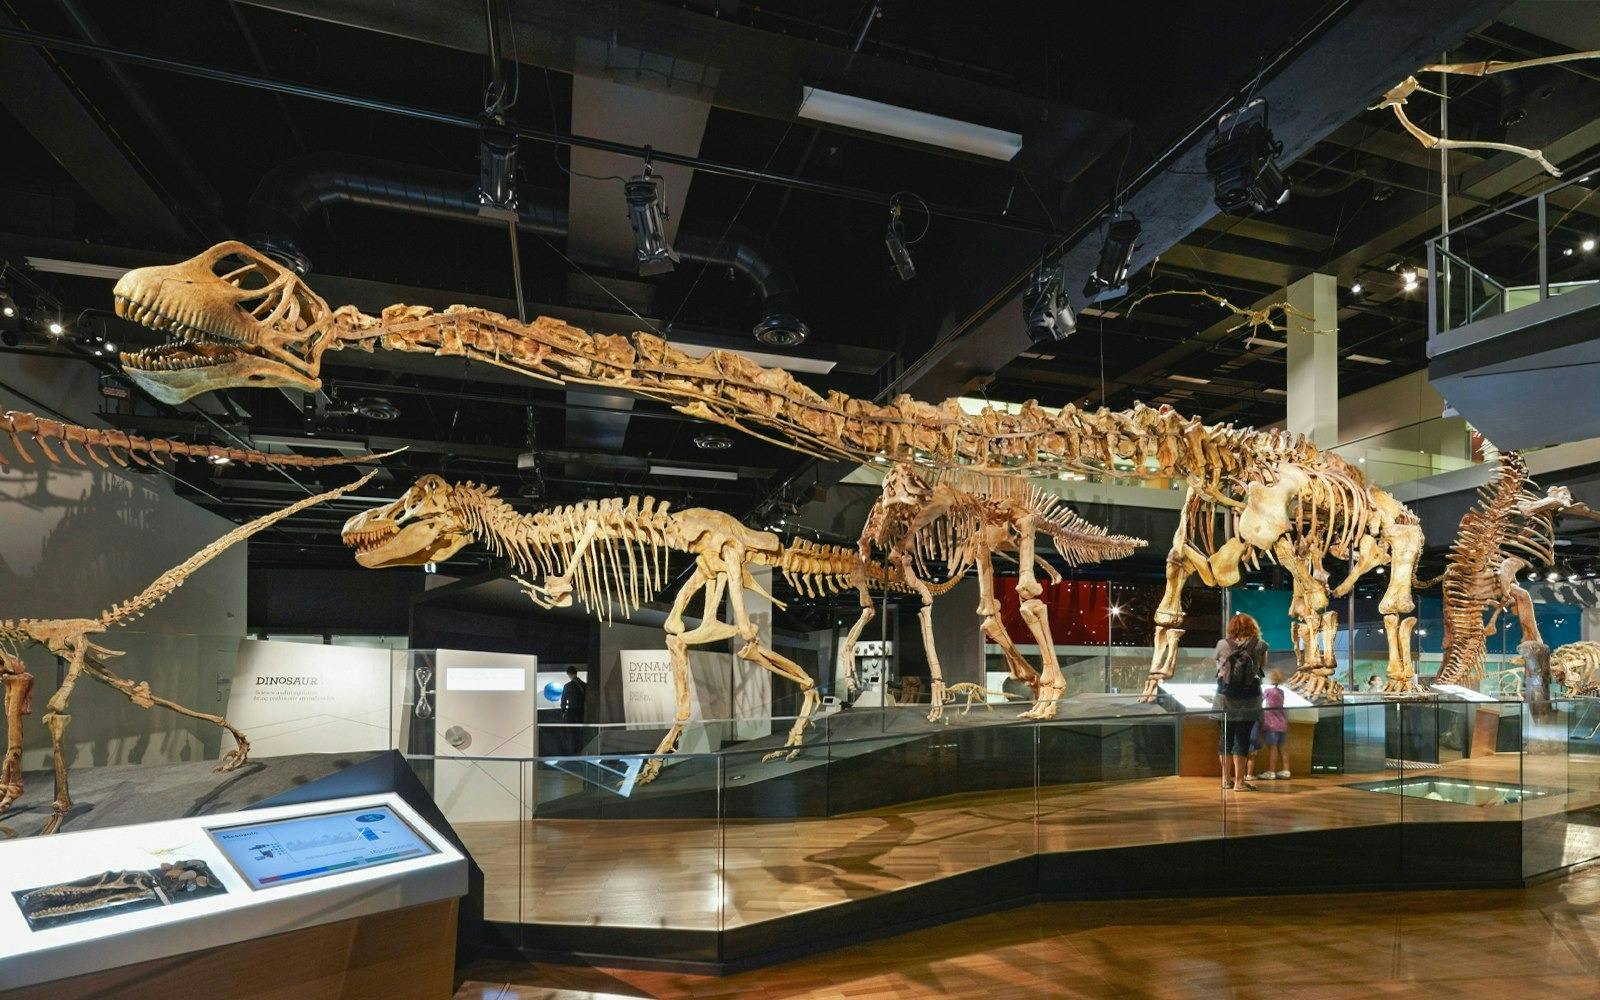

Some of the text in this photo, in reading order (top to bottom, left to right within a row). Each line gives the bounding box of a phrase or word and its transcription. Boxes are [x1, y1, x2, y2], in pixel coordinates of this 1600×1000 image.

[629, 661, 671, 672] DYNAM
[255, 676, 319, 686] DINOSAUR
[629, 672, 667, 683] EARTH
